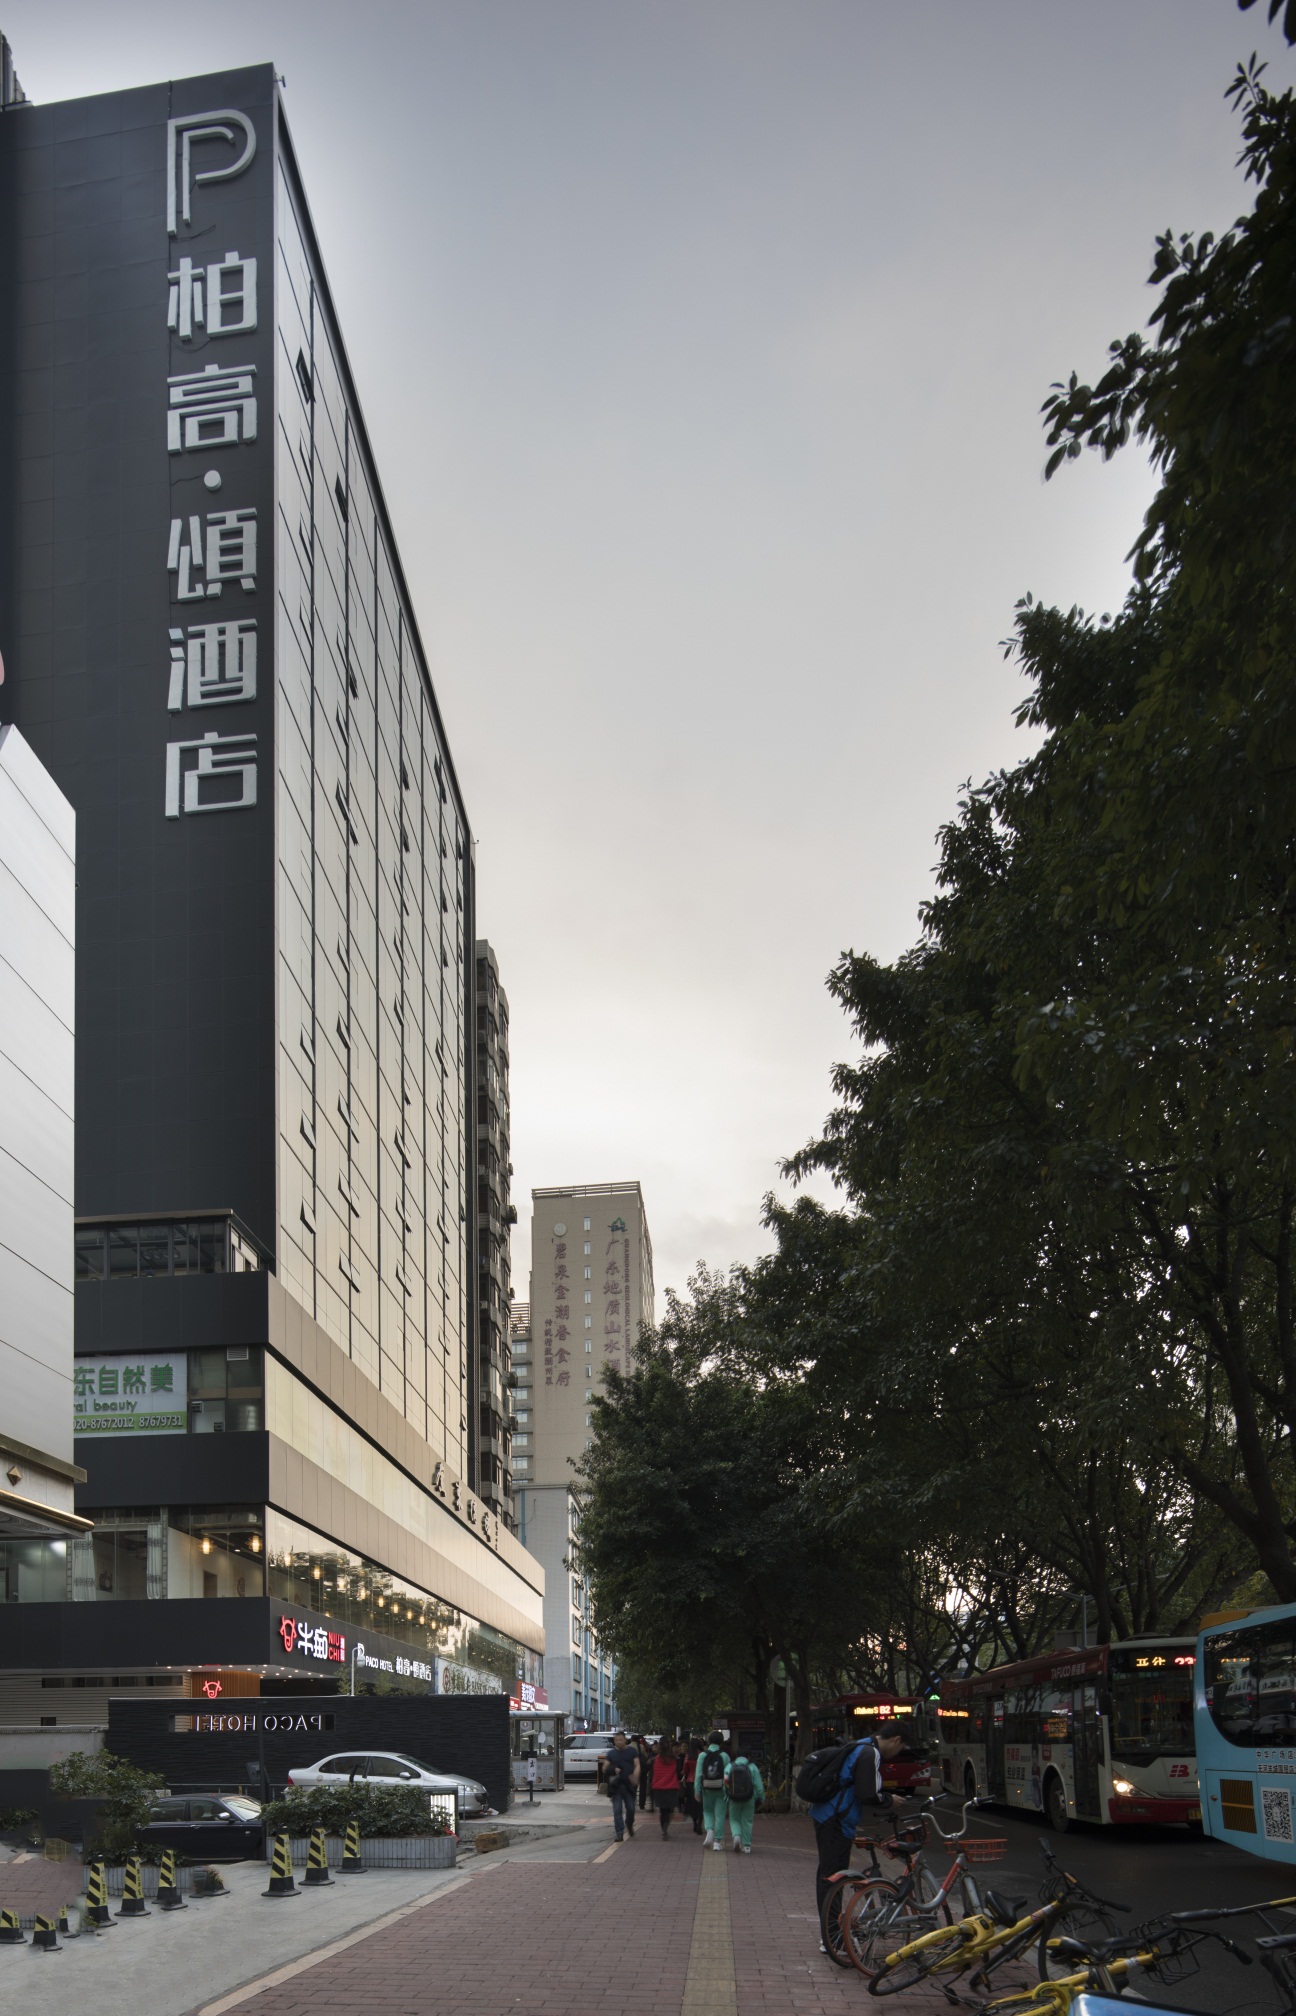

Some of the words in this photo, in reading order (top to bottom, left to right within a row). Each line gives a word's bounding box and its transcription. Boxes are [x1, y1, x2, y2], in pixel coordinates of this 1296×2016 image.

[93, 1399, 138, 1413] beauty
[139, 1414, 183, 1428] 87679731
[328, 1632, 340, 1647] NIU
[328, 1646, 340, 1661] CHI
[365, 1655, 379, 1669] PACO
[380, 1658, 394, 1673] HOTEL
